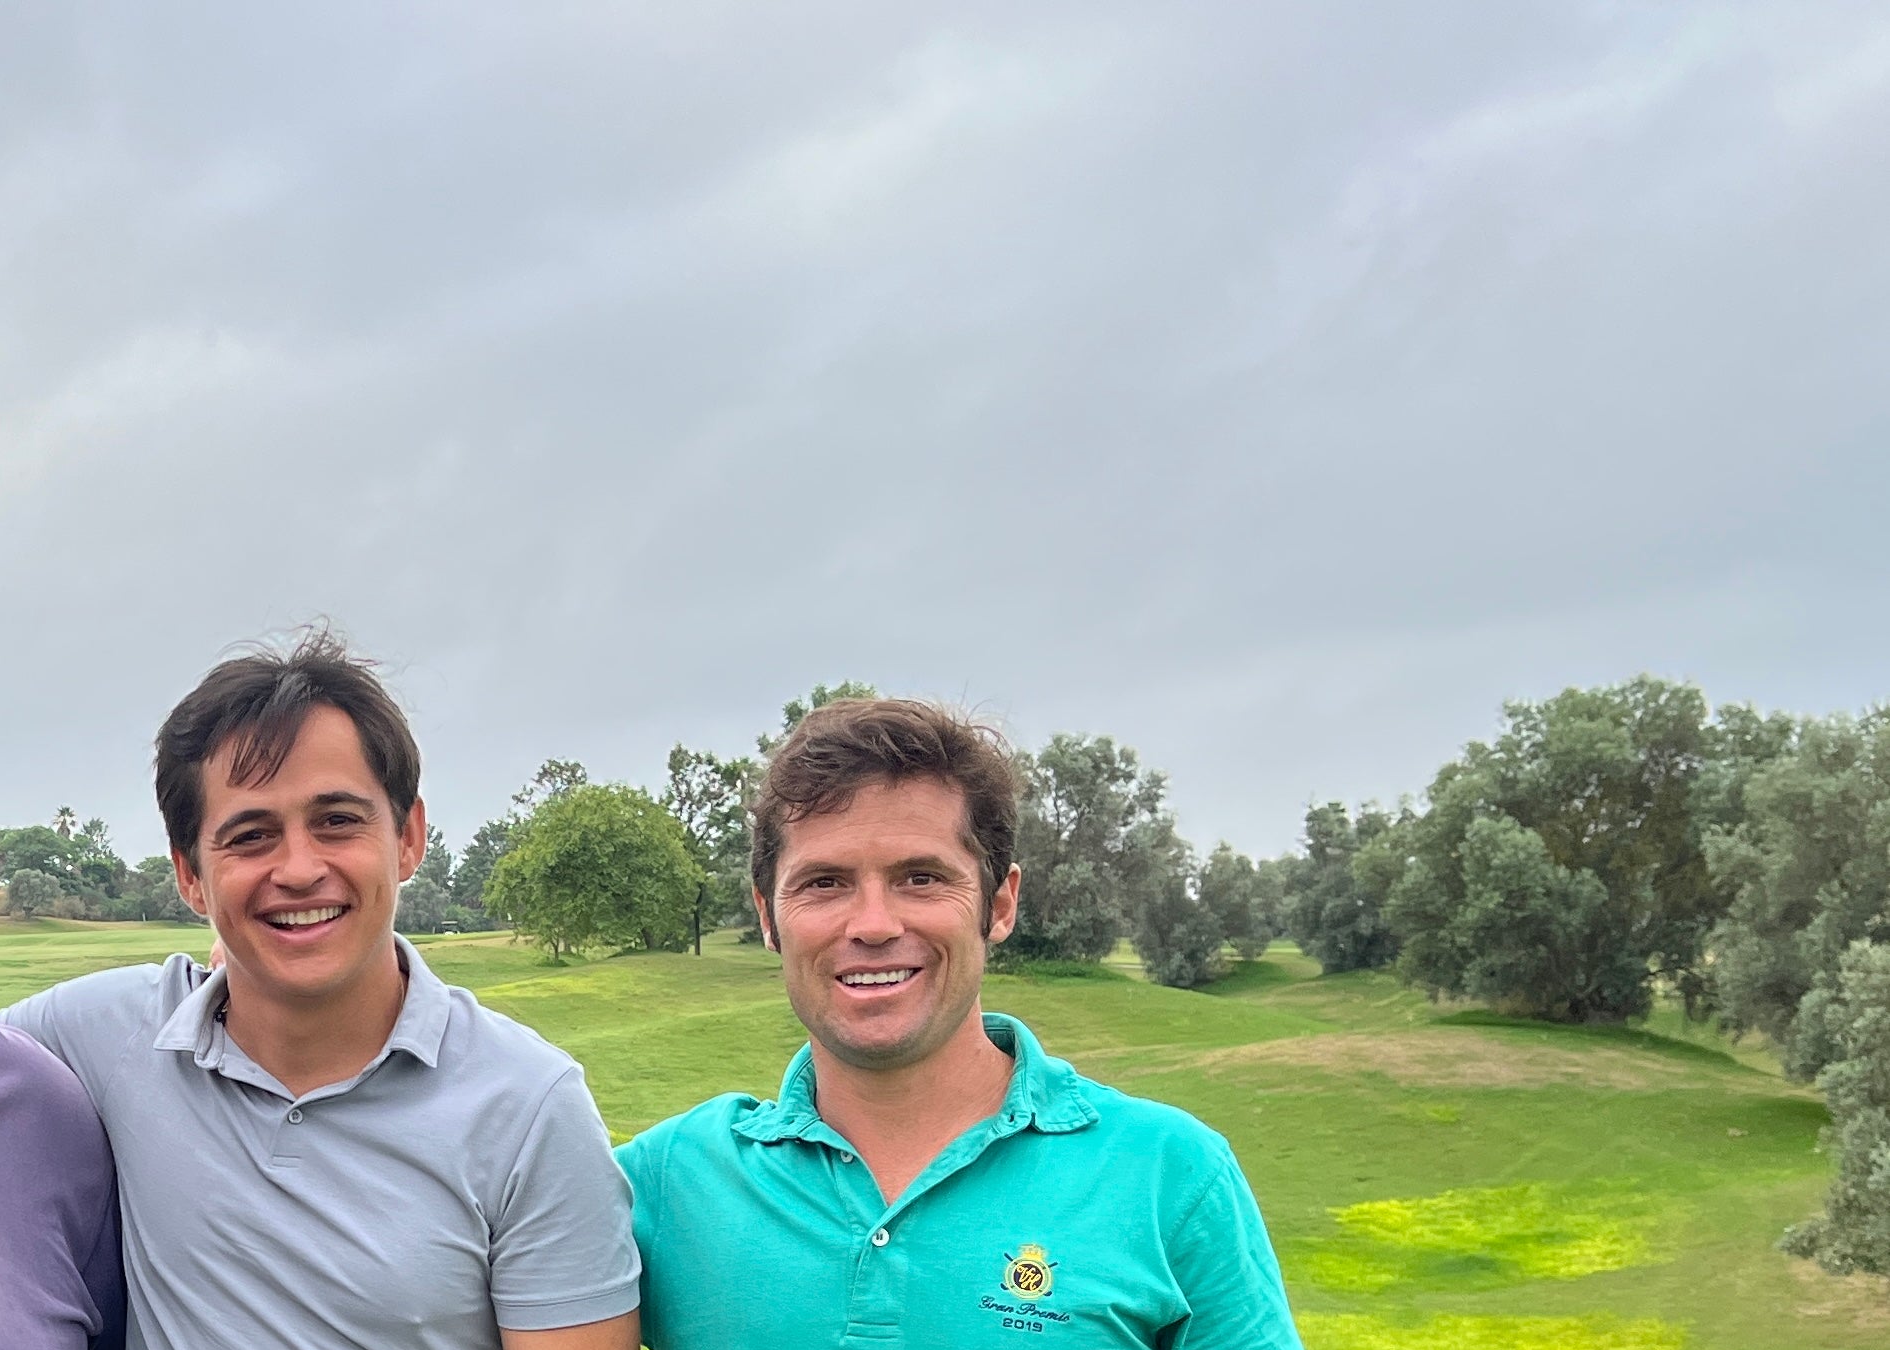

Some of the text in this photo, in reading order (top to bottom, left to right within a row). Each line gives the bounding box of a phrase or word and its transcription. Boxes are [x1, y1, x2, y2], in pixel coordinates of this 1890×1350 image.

[978, 1295, 1070, 1322] Gran Premio
[1002, 1318, 1043, 1332] 2019
